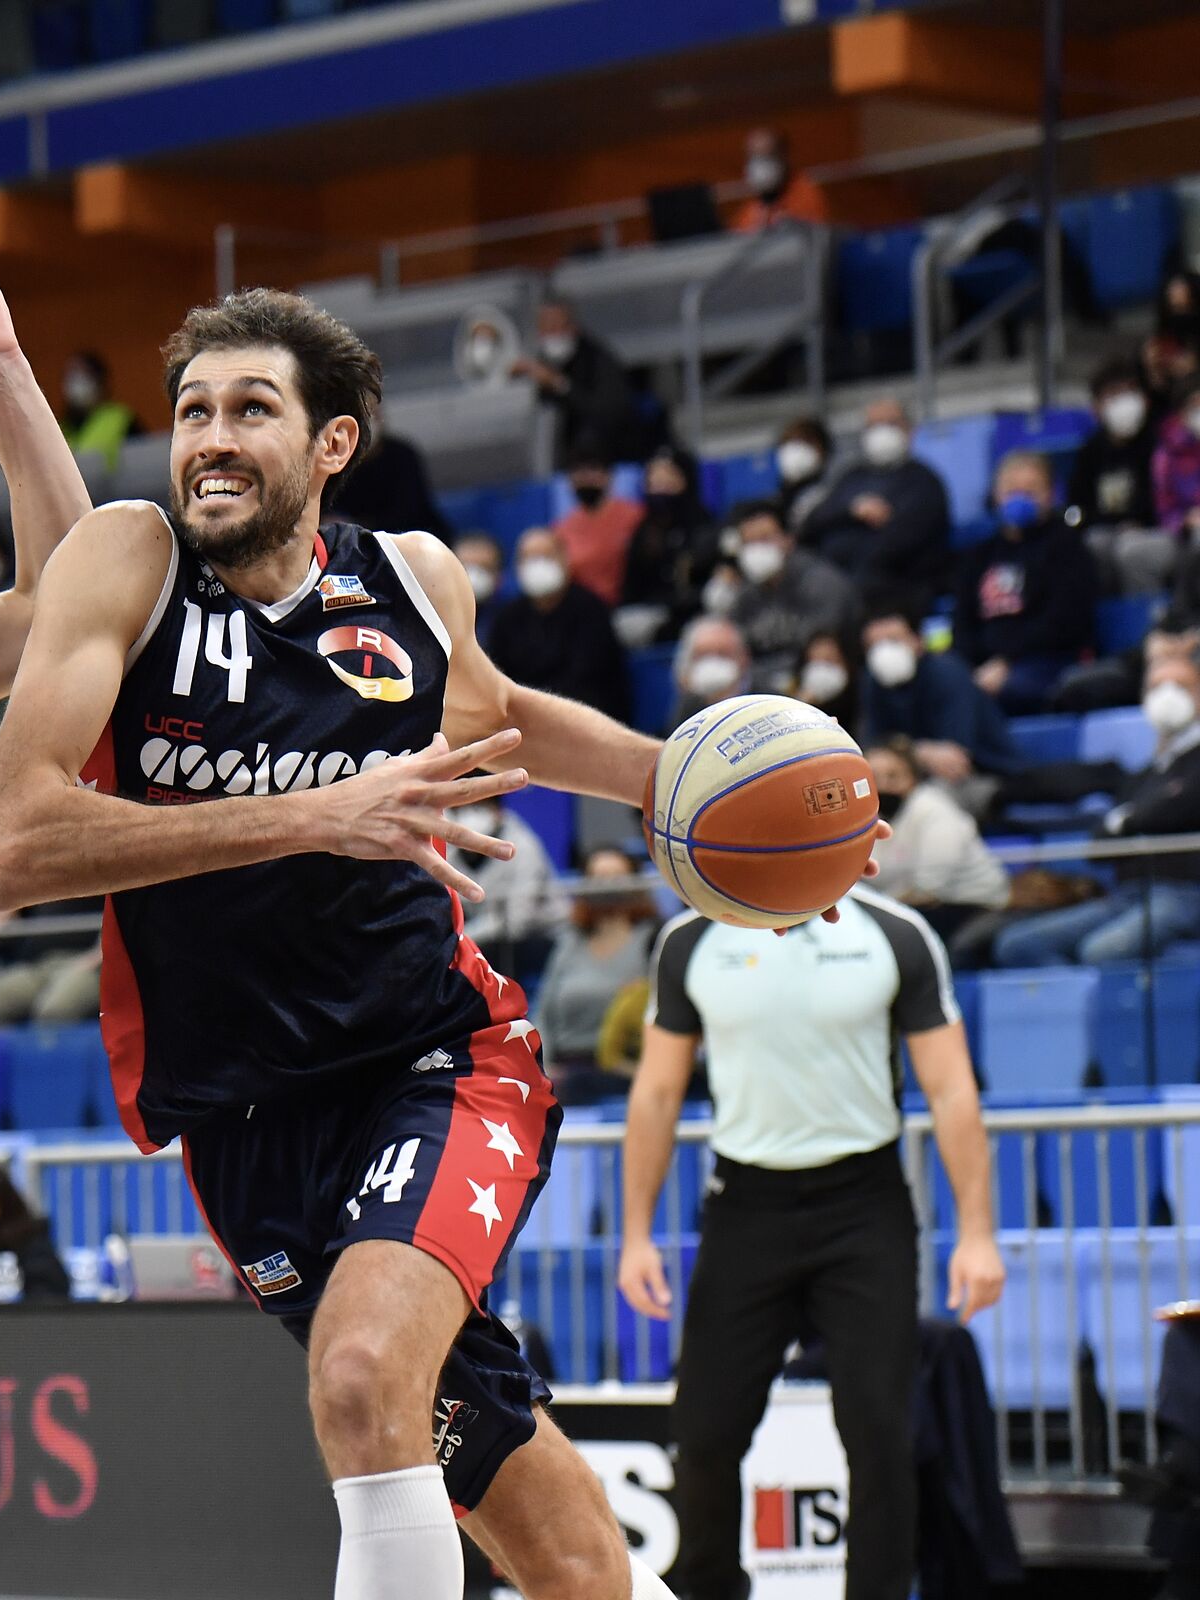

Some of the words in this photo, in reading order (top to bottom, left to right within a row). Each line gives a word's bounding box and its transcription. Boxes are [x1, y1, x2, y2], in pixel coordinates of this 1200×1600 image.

[172, 597, 252, 703] 14
[144, 713, 204, 741] UCC
[346, 1138, 421, 1221] 14
